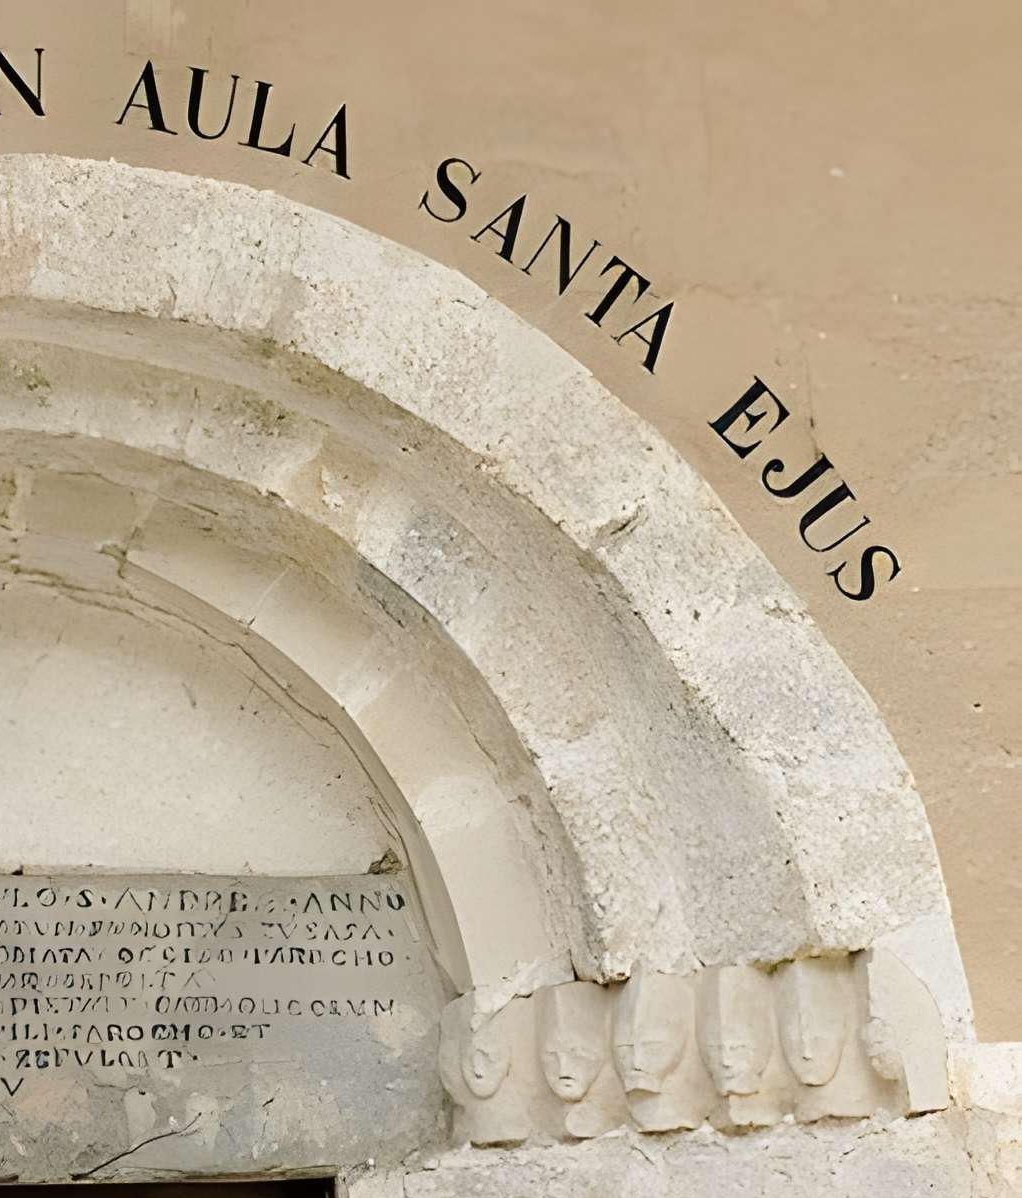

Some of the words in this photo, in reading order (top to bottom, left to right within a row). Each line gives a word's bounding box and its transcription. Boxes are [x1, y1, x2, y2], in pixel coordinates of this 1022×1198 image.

[115, 60, 352, 180] AULA
[419, 157, 675, 375] SANTA
[707, 375, 901, 602] EJUS
